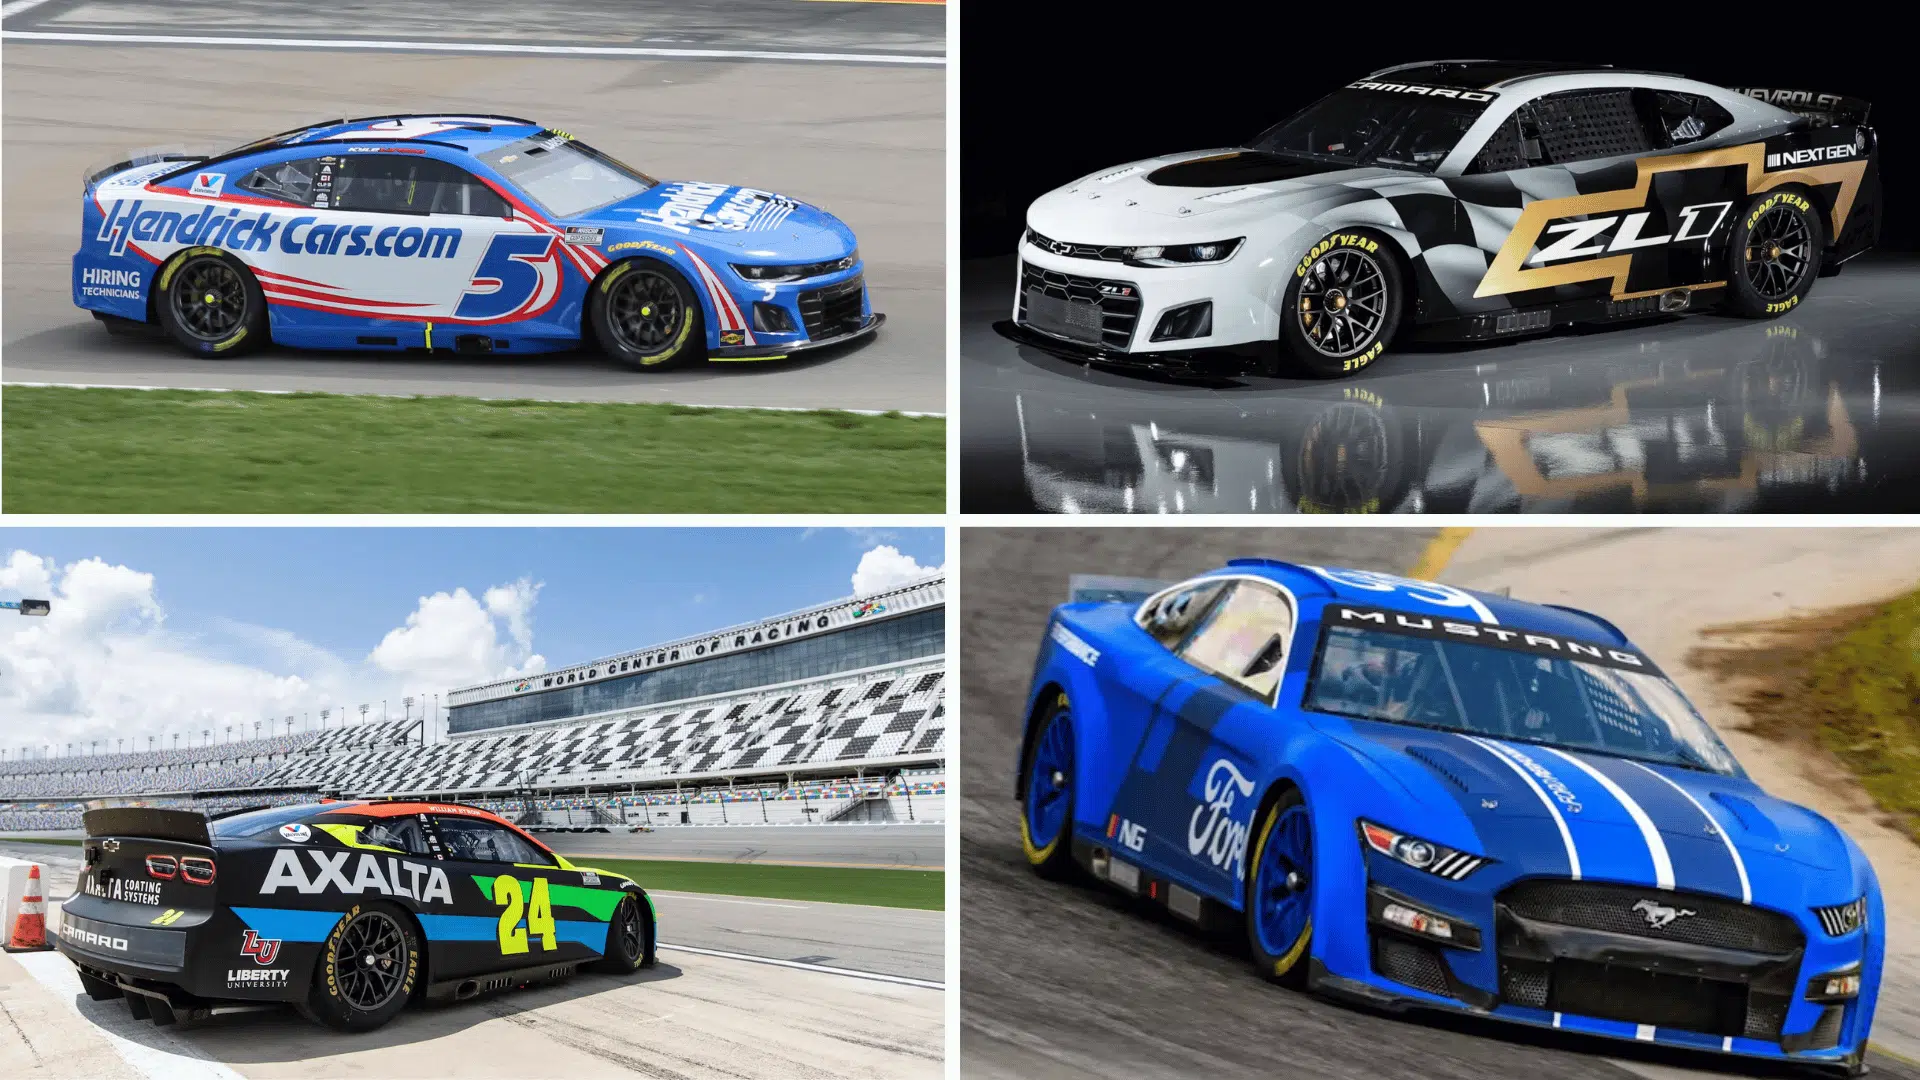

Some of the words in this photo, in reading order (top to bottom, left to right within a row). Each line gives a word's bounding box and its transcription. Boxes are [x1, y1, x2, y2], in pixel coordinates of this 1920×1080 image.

[1345, 81, 1493, 102] CAMARO
[1783, 147, 1826, 165] NEXT
[1826, 143, 1857, 159] GEN
[1747, 193, 1810, 230] GOODYEAR
[607, 240, 677, 256] GOODYEAR
[1529, 200, 1734, 264] ZL1
[1296, 233, 1379, 277] GOODYEAR
[82, 267, 141, 288] HIRING
[82, 286, 140, 300] TECHNICIANS
[452, 231, 565, 326] 5
[1766, 294, 1799, 313] EAGLE
[1343, 341, 1384, 371] EAGLE
[542, 668, 598, 690] WORLD
[608, 648, 681, 675] CENTER
[694, 640, 722, 657] OF
[734, 615, 830, 648] RACING
[1340, 608, 1644, 668] MUSTANG
[1118, 818, 1148, 852] NG
[124, 879, 162, 894] COATING
[259, 848, 455, 905] AXALTA
[123, 890, 160, 906] SYSTEMS
[492, 873, 558, 956] 24
[62, 923, 128, 952] CAMARO
[240, 929, 282, 966] LU
[326, 904, 361, 997] GOODYEAR
[226, 981, 288, 990] UNIVERSITY
[227, 969, 290, 982] LIBERTY
[402, 950, 418, 995] EAGLE
